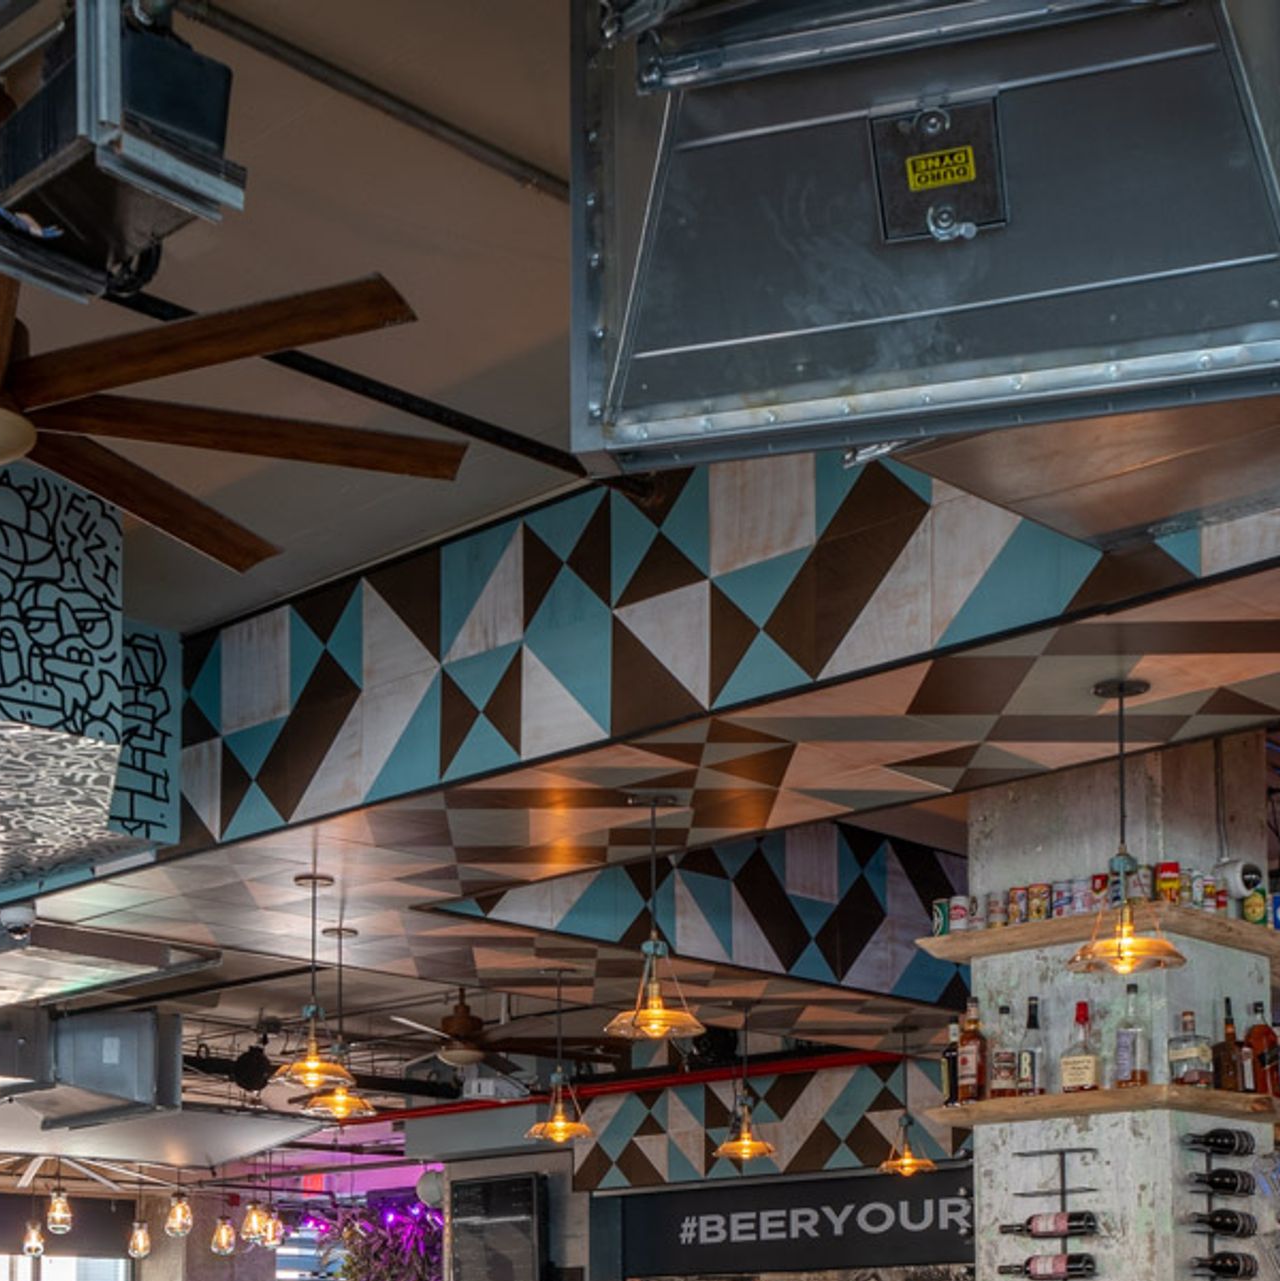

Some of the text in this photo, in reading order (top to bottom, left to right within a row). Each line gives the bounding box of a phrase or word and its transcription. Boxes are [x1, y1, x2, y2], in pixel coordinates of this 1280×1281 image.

[915, 152, 966, 172] DYNE
[917, 165, 968, 185] DURO
[679, 1198, 972, 1245] #BEERYOUR
